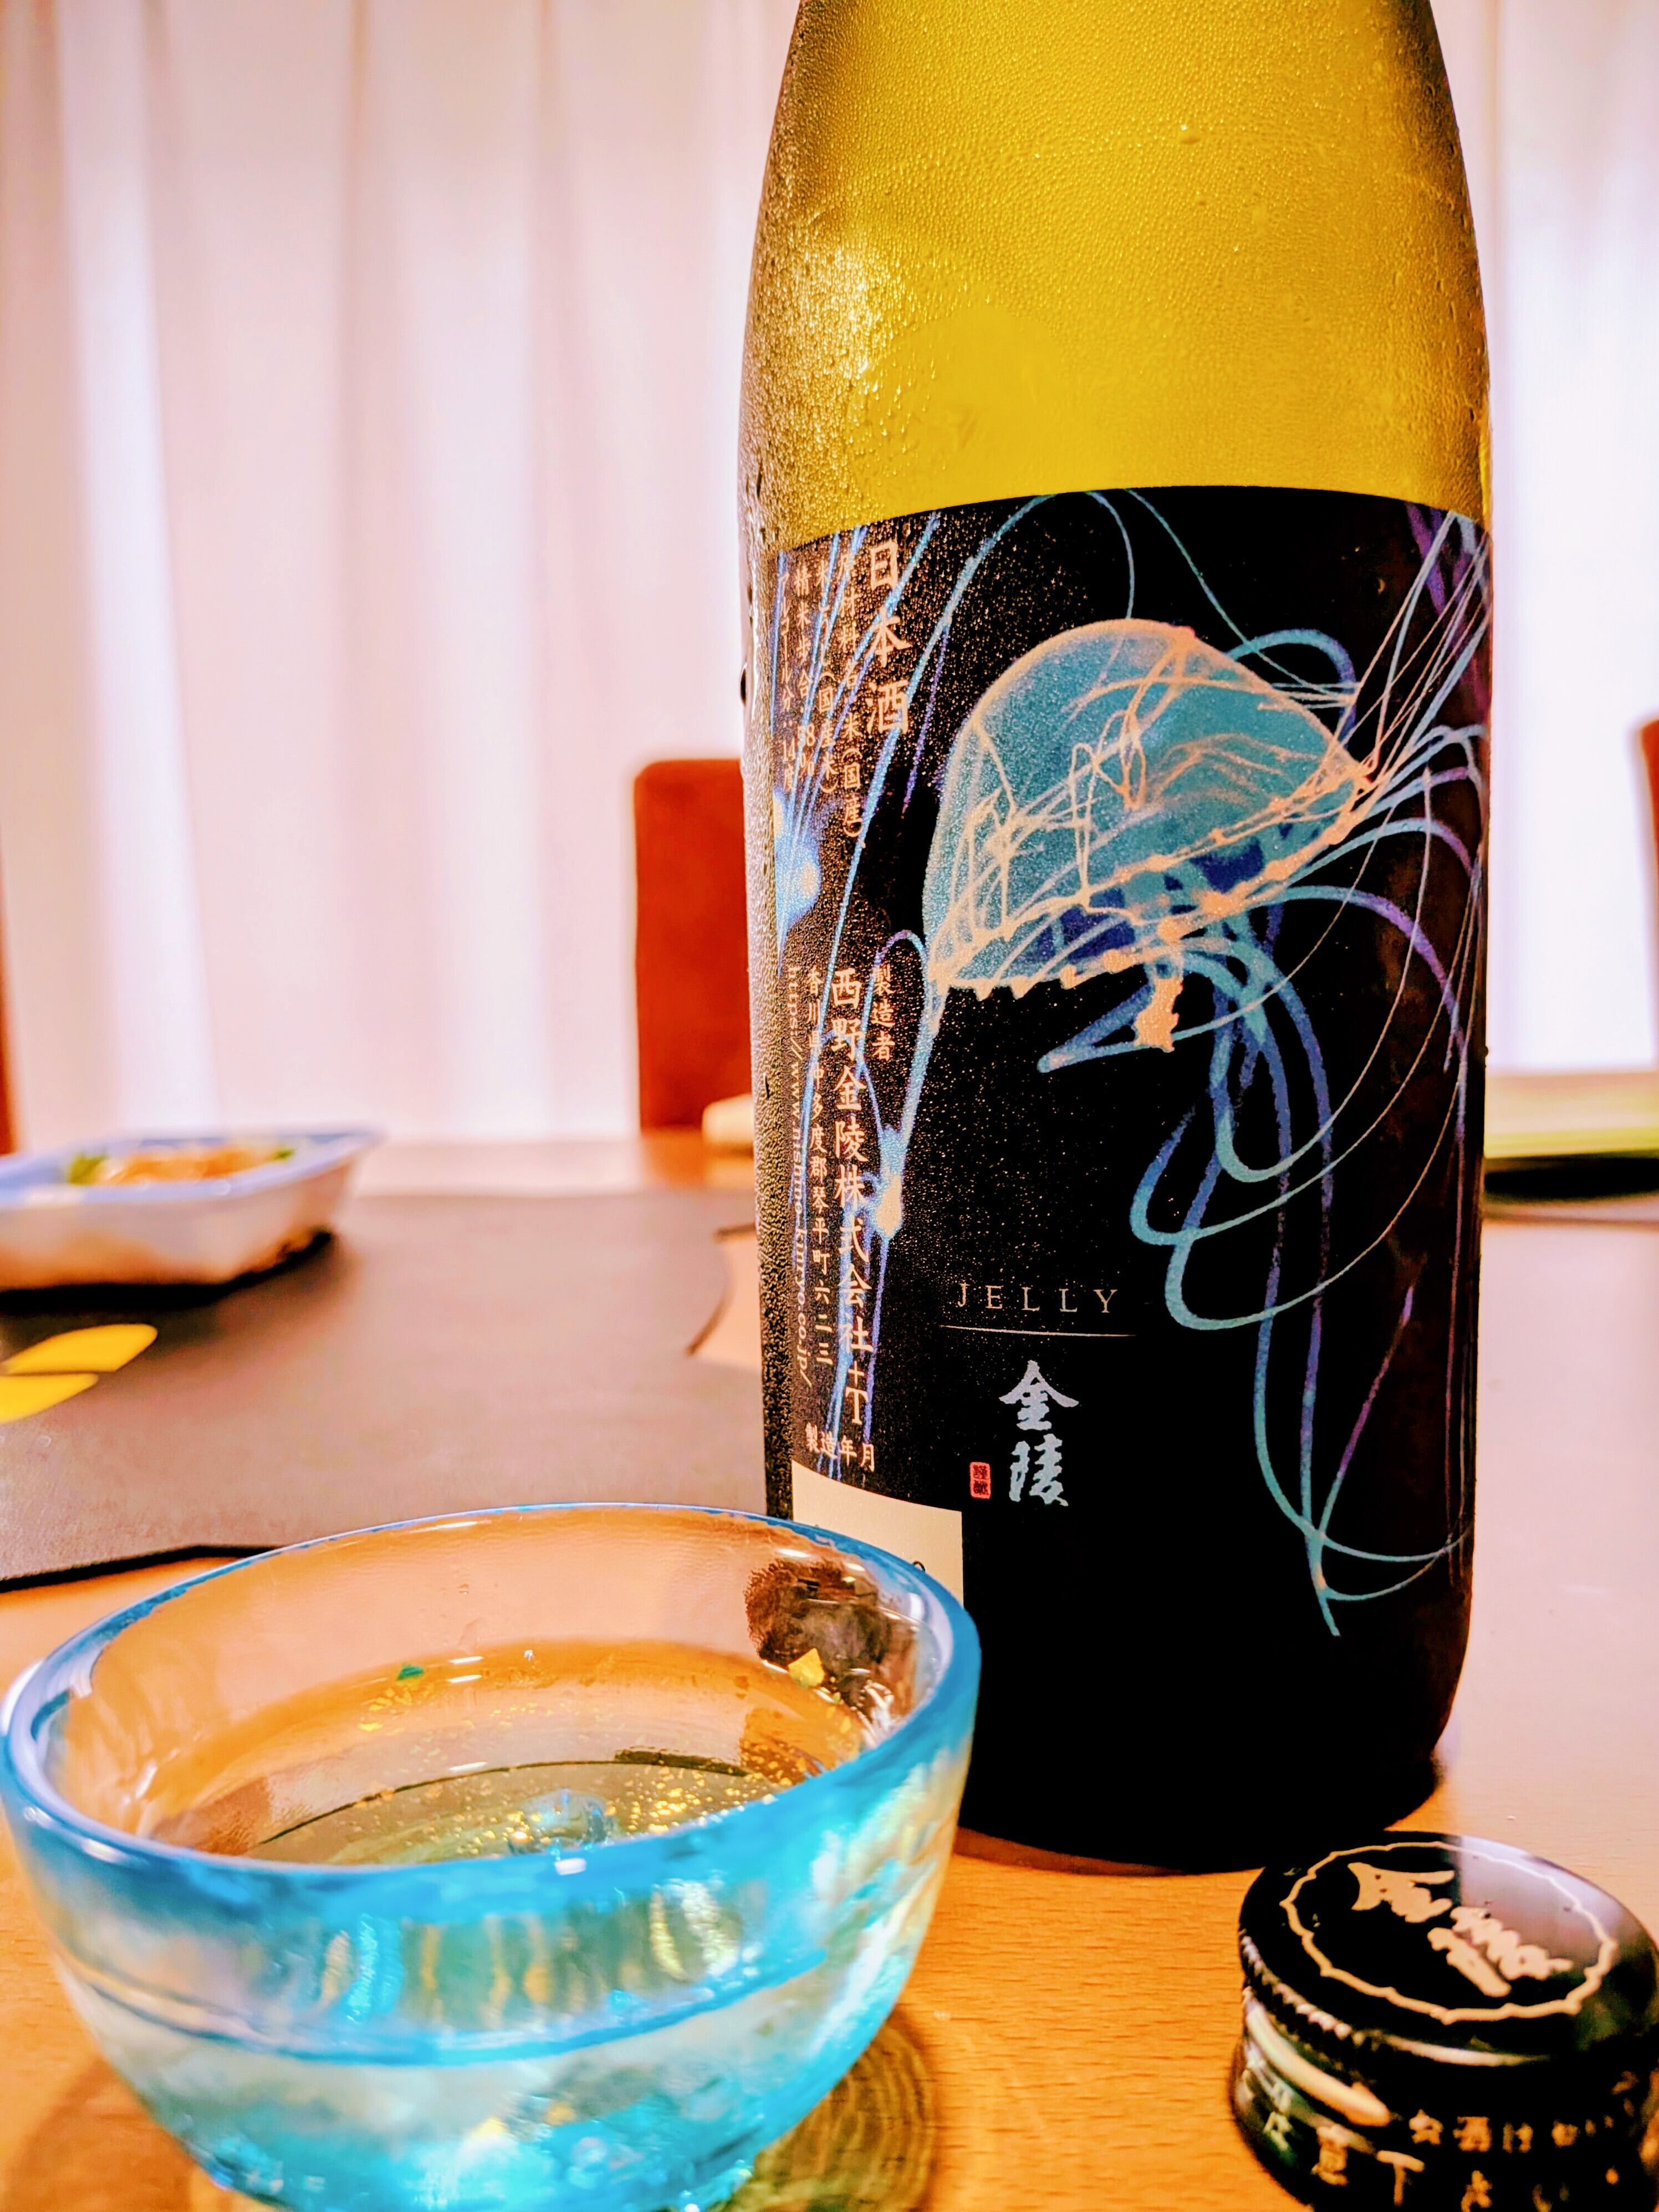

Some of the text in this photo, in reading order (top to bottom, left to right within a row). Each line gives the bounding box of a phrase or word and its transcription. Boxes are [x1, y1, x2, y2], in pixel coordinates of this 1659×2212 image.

[865, 538, 911, 735] 日本酒
[871, 966, 895, 1062] 製造者
[957, 1282, 1118, 1313] JELLY
[805, 1422, 875, 1472] 製造年月
[998, 1359, 1080, 1507] 金陵
